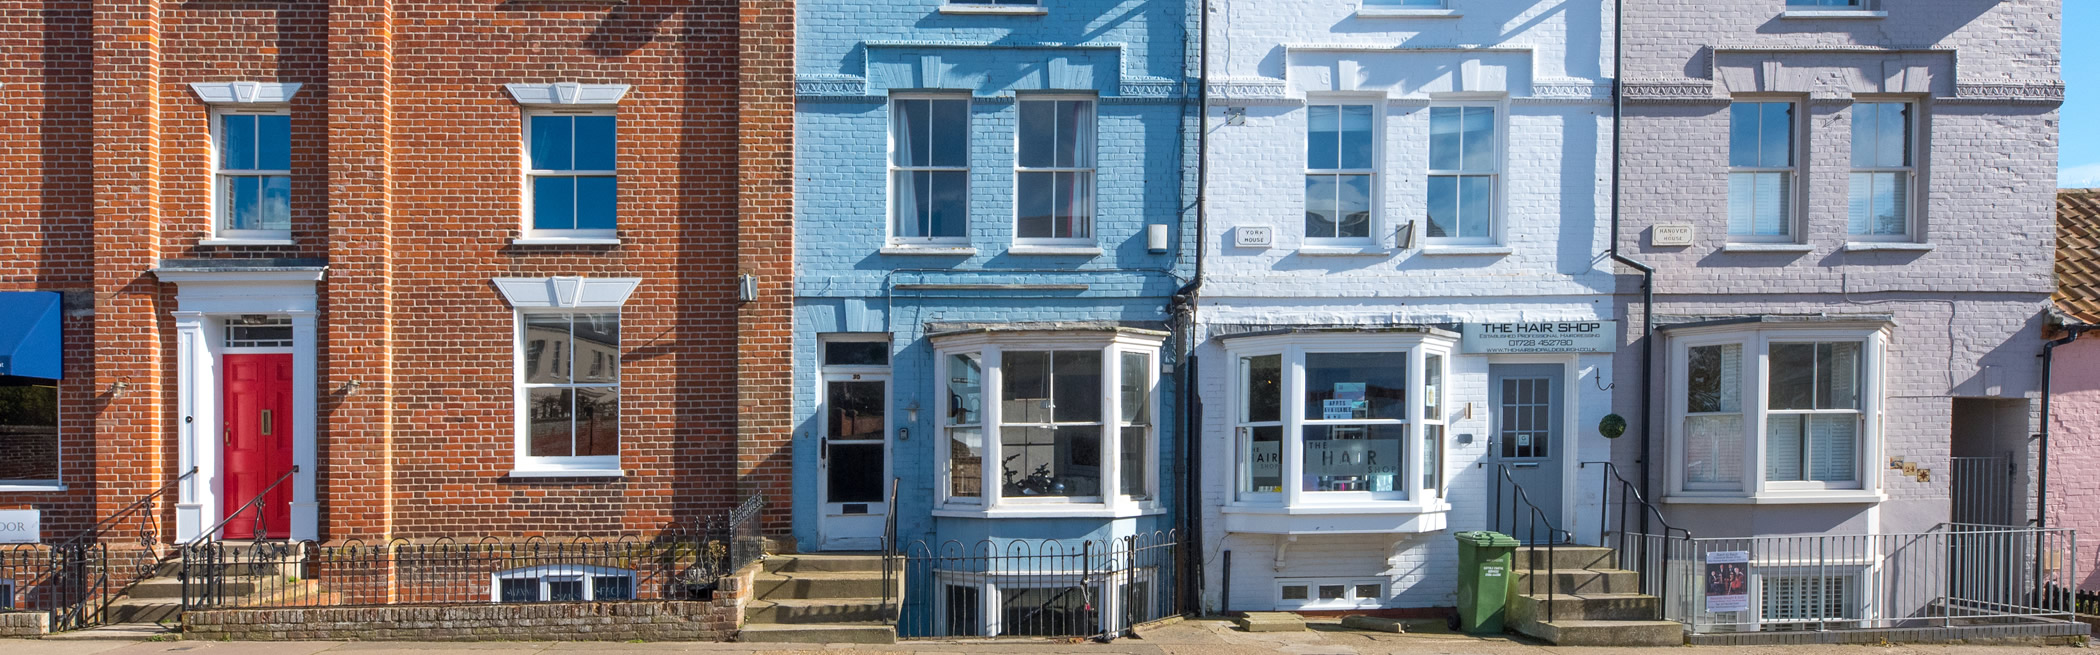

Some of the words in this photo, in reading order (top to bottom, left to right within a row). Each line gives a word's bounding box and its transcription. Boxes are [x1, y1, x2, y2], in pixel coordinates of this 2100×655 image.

[1481, 323, 1513, 333] THE
[1517, 323, 1553, 333] HAIR
[1558, 323, 1600, 332] SHOP
[1322, 450, 1377, 466] HAIR
[1368, 465, 1397, 473] SHOP
